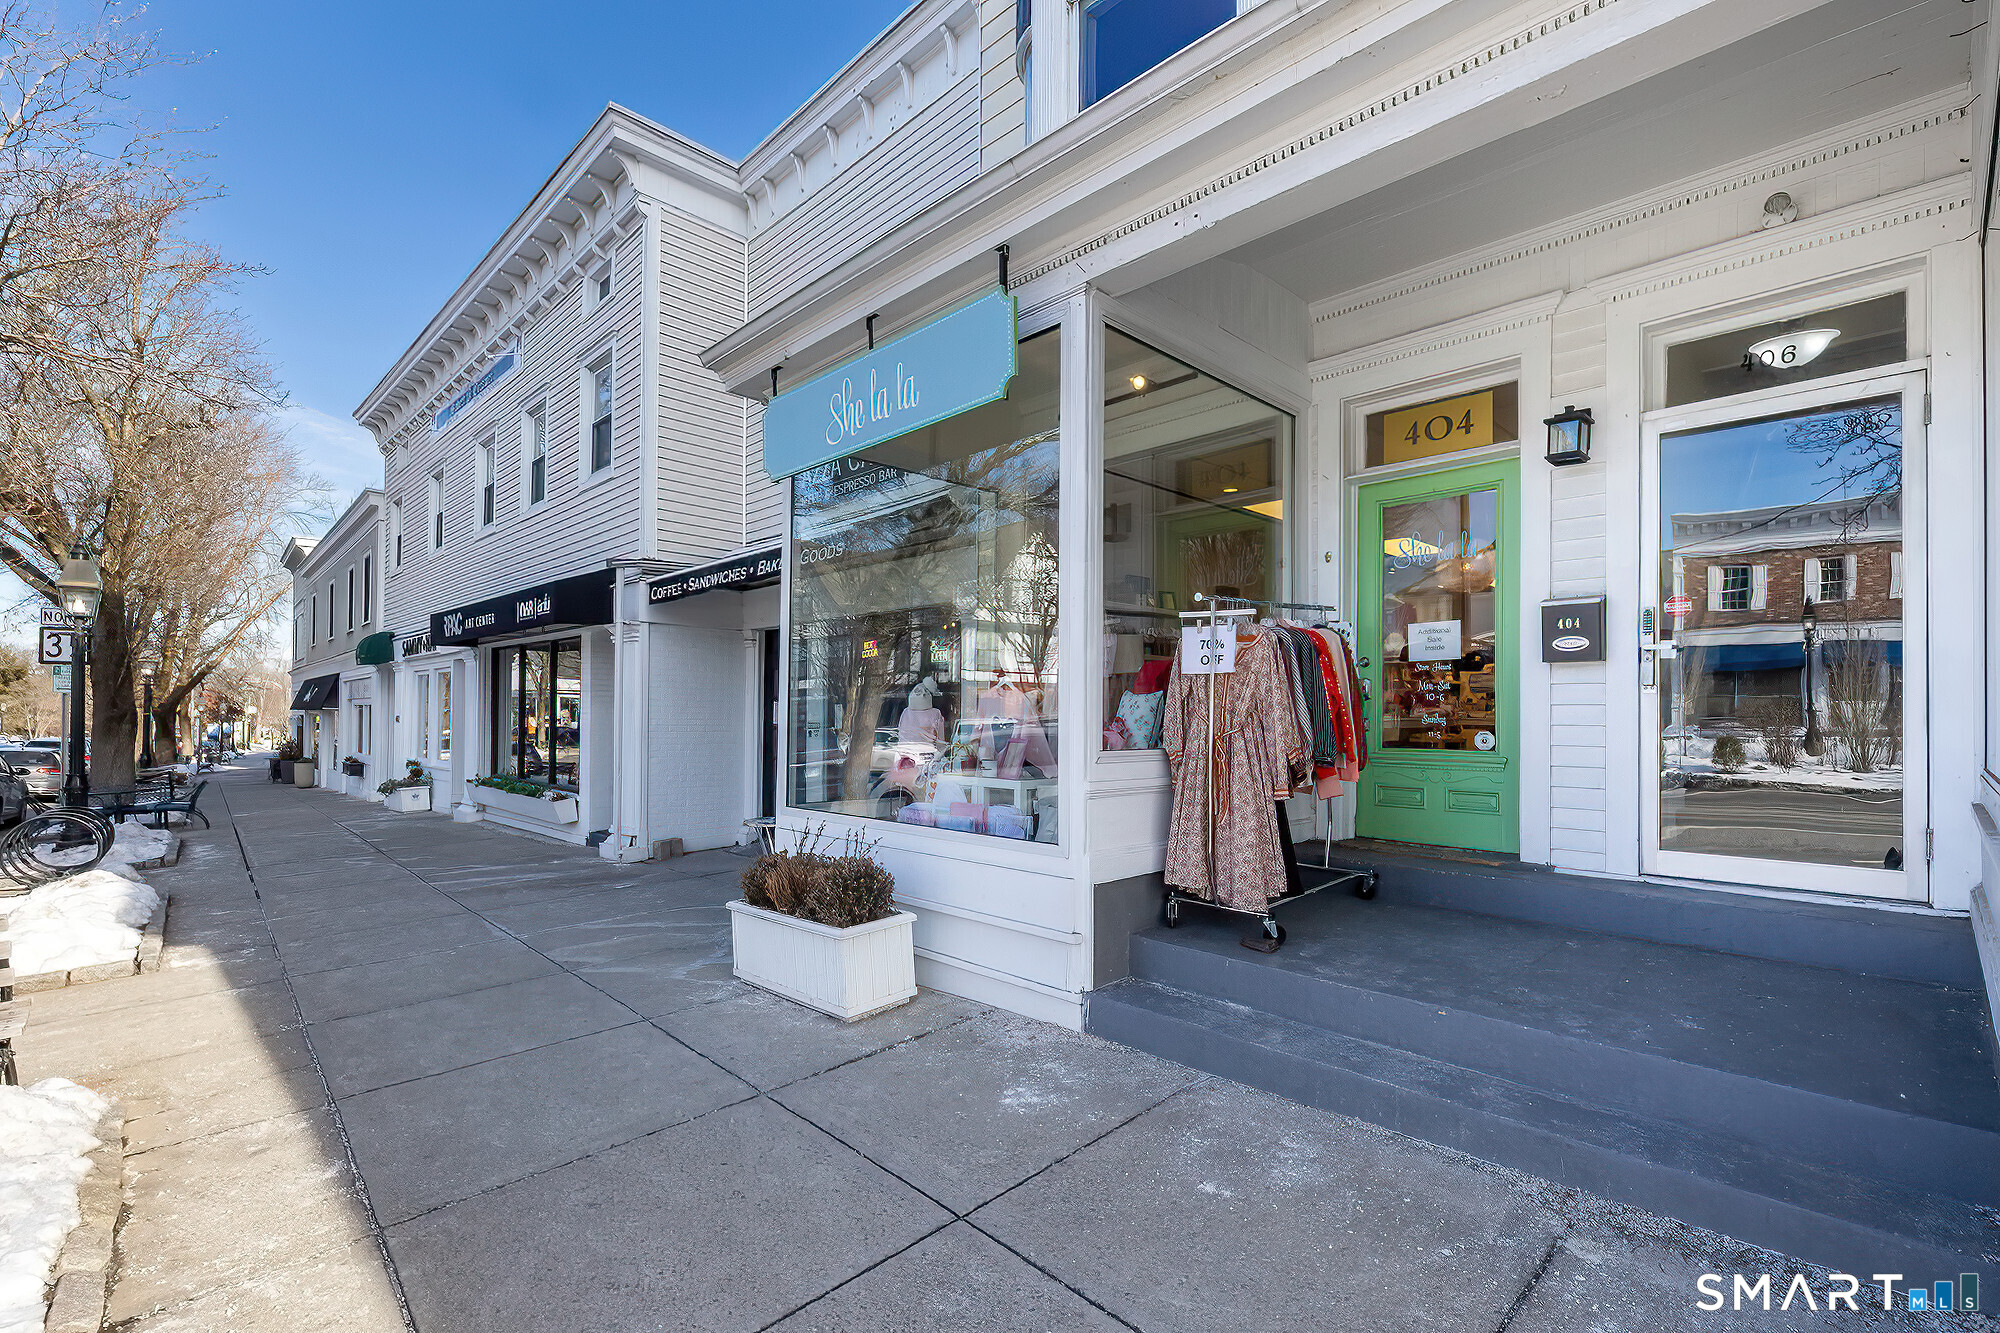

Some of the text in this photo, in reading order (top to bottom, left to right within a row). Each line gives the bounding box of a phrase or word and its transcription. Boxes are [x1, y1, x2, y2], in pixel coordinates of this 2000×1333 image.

[1741, 345, 1797, 371] 406
[826, 362, 919, 445] She la la
[1404, 409, 1474, 445] 404
[800, 542, 843, 565] GOODS
[651, 583, 682, 600] COFFEE
[688, 566, 747, 591] SANDWICHES
[1557, 617, 1581, 630] 404
[1200, 639, 1225, 650] 70%
